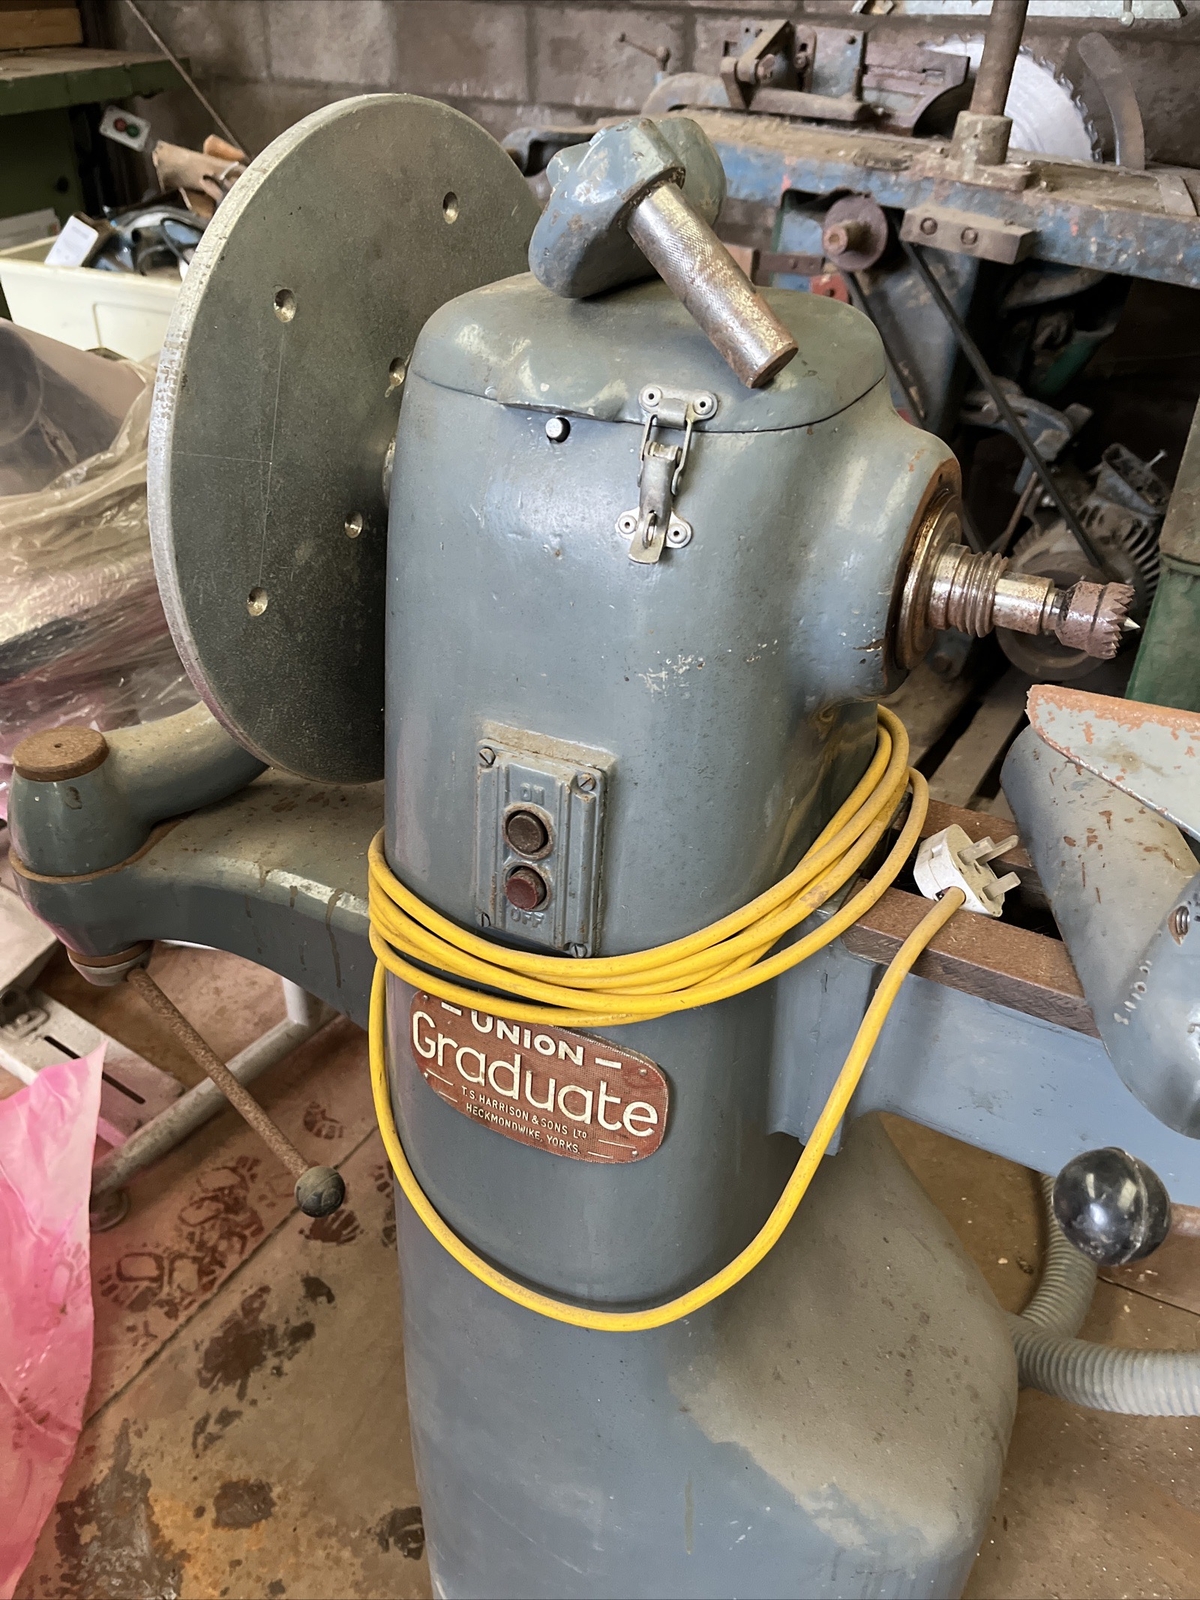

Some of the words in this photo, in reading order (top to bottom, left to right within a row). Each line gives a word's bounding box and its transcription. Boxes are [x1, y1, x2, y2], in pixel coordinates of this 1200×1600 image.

[510, 907, 545, 929] OFF
[470, 1009, 585, 1066] UNION
[412, 1010, 659, 1138] Graduate
[466, 1102, 544, 1143] HECKMONDWIKE,
[546, 1134, 582, 1155] YORKS.
[479, 1094, 529, 1122] HARRISON
[531, 1115, 540, 1126] &
[540, 1117, 568, 1135] SONS
